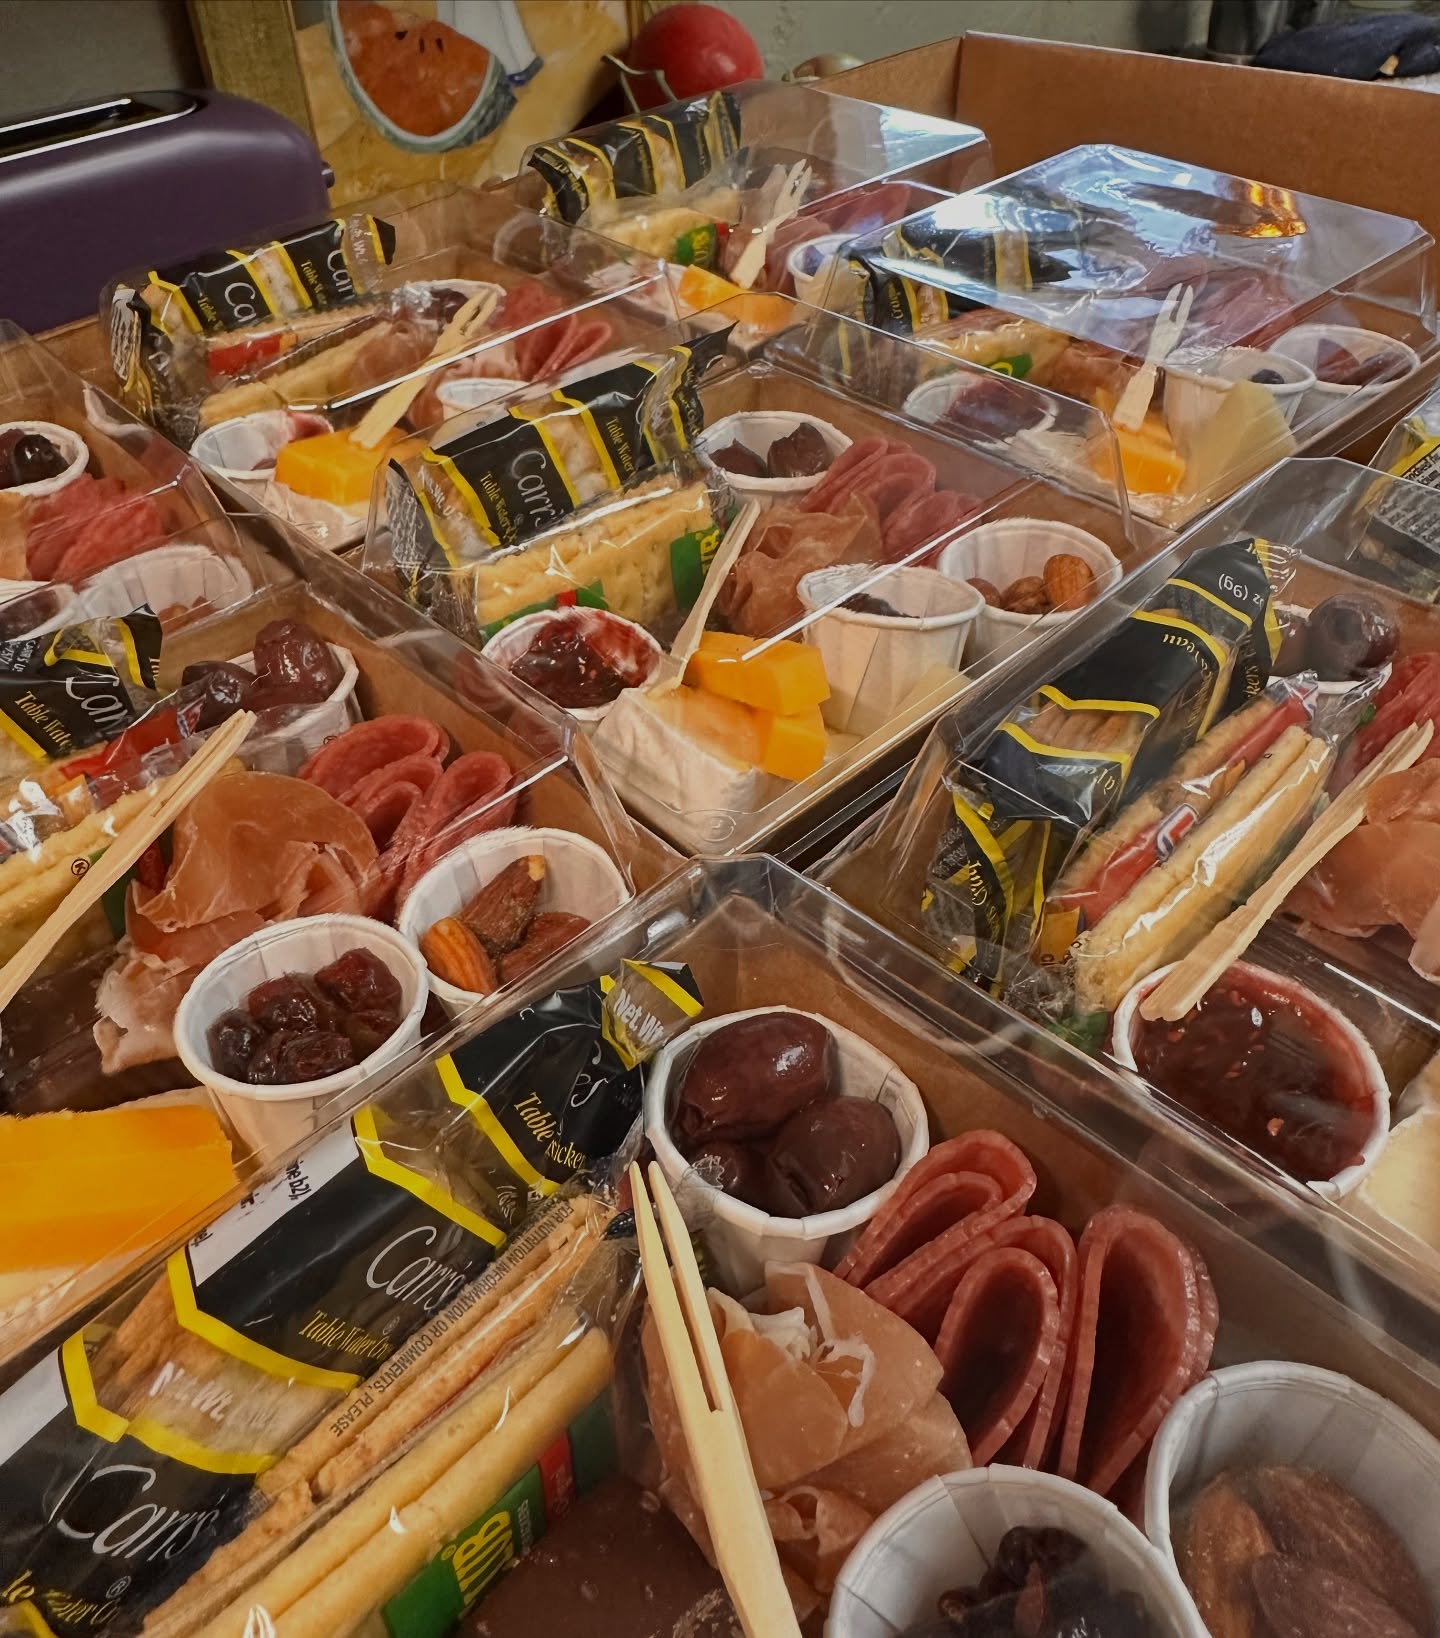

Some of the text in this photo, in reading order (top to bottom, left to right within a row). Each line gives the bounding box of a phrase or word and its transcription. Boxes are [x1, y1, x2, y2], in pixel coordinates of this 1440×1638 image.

[605, 415, 624, 445] Table
[479, 470, 500, 502] Table
[1218, 573, 1249, 601] (9g)
[14, 690, 49, 724] Table
[513, 1091, 558, 1143] Table
[555, 1204, 575, 1223] FOR
[507, 1214, 559, 1267] NUTRITION
[366, 1225, 473, 1311] Carr's
[449, 1262, 512, 1325] INFORMATION
[298, 1309, 347, 1348] Table
[337, 1326, 378, 1356] Water
[431, 1319, 450, 1339] OR
[366, 1335, 434, 1393] COMMENTS,
[329, 1388, 375, 1438] PLEASE
[56, 1463, 230, 1562] Carr's
